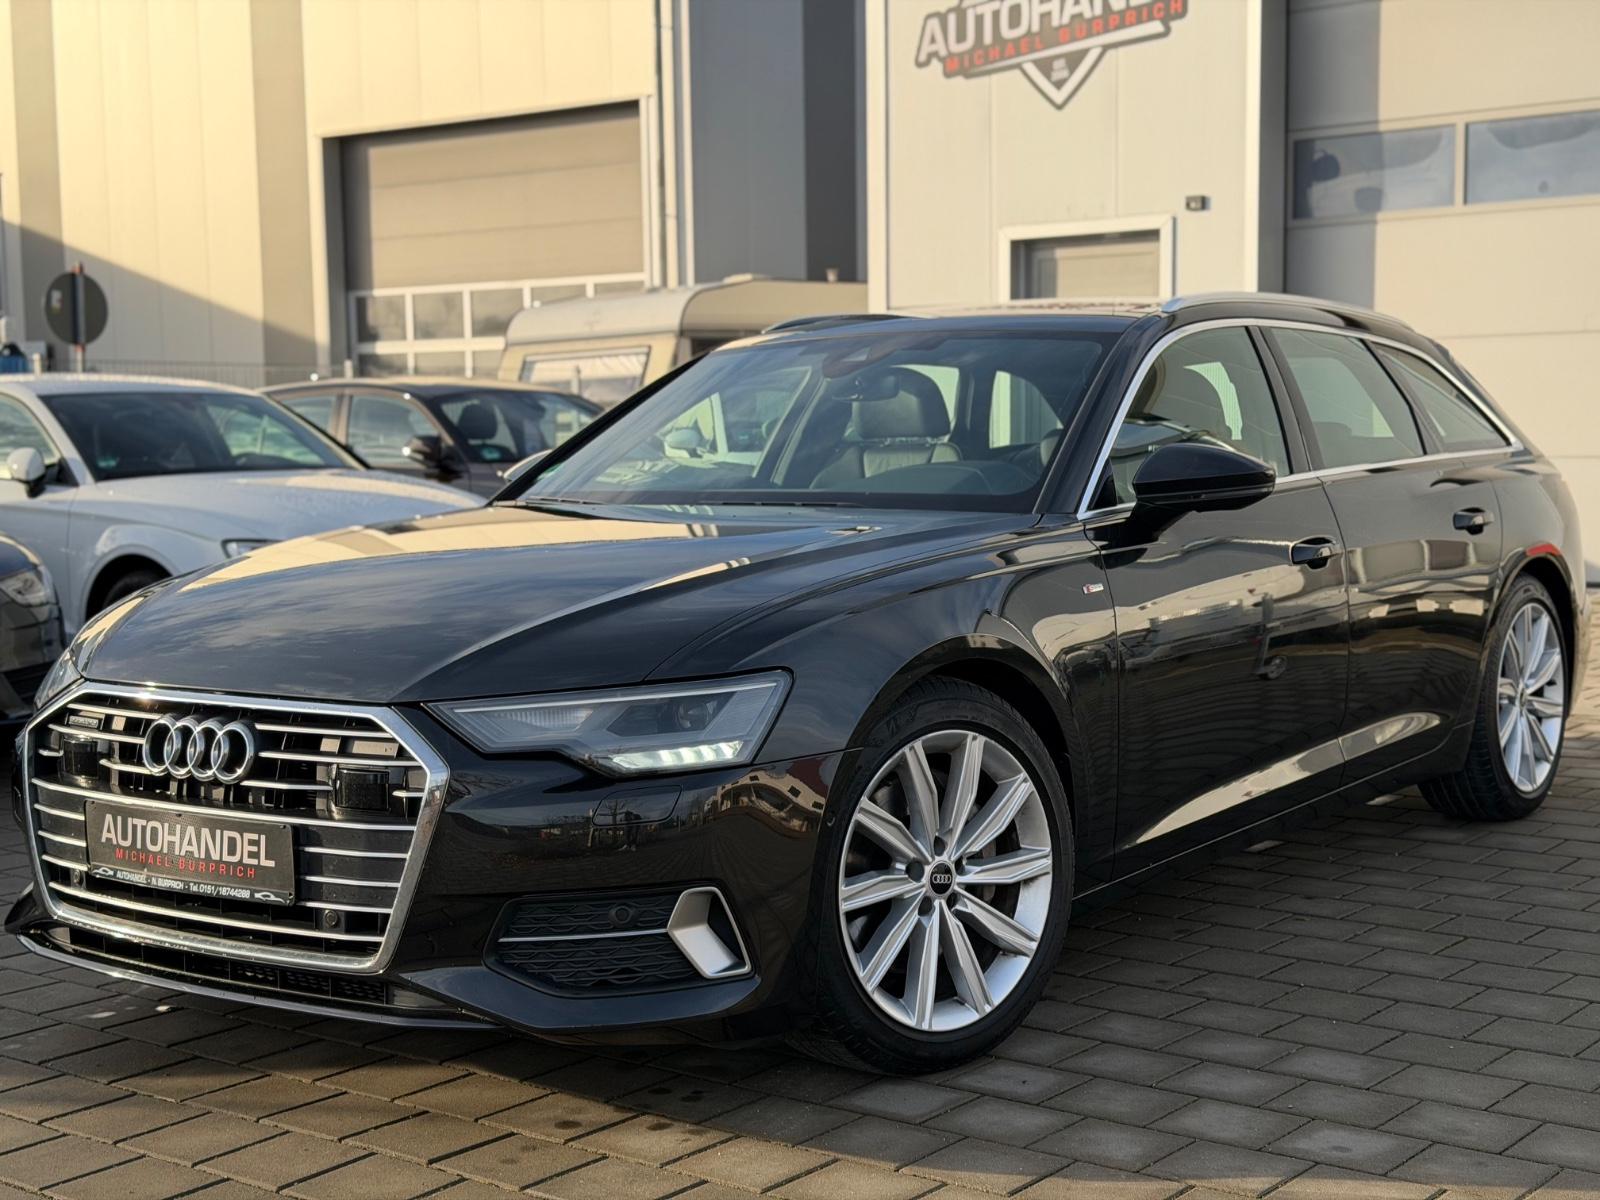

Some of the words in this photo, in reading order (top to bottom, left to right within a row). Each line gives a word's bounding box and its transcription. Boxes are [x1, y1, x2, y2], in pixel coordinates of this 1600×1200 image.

[945, 38, 1044, 72] MICHAEL
[101, 813, 276, 868] AUTOHANDEL
[115, 848, 171, 867] MICHAEL
[116, 870, 148, 884] AUTOHANDEL
